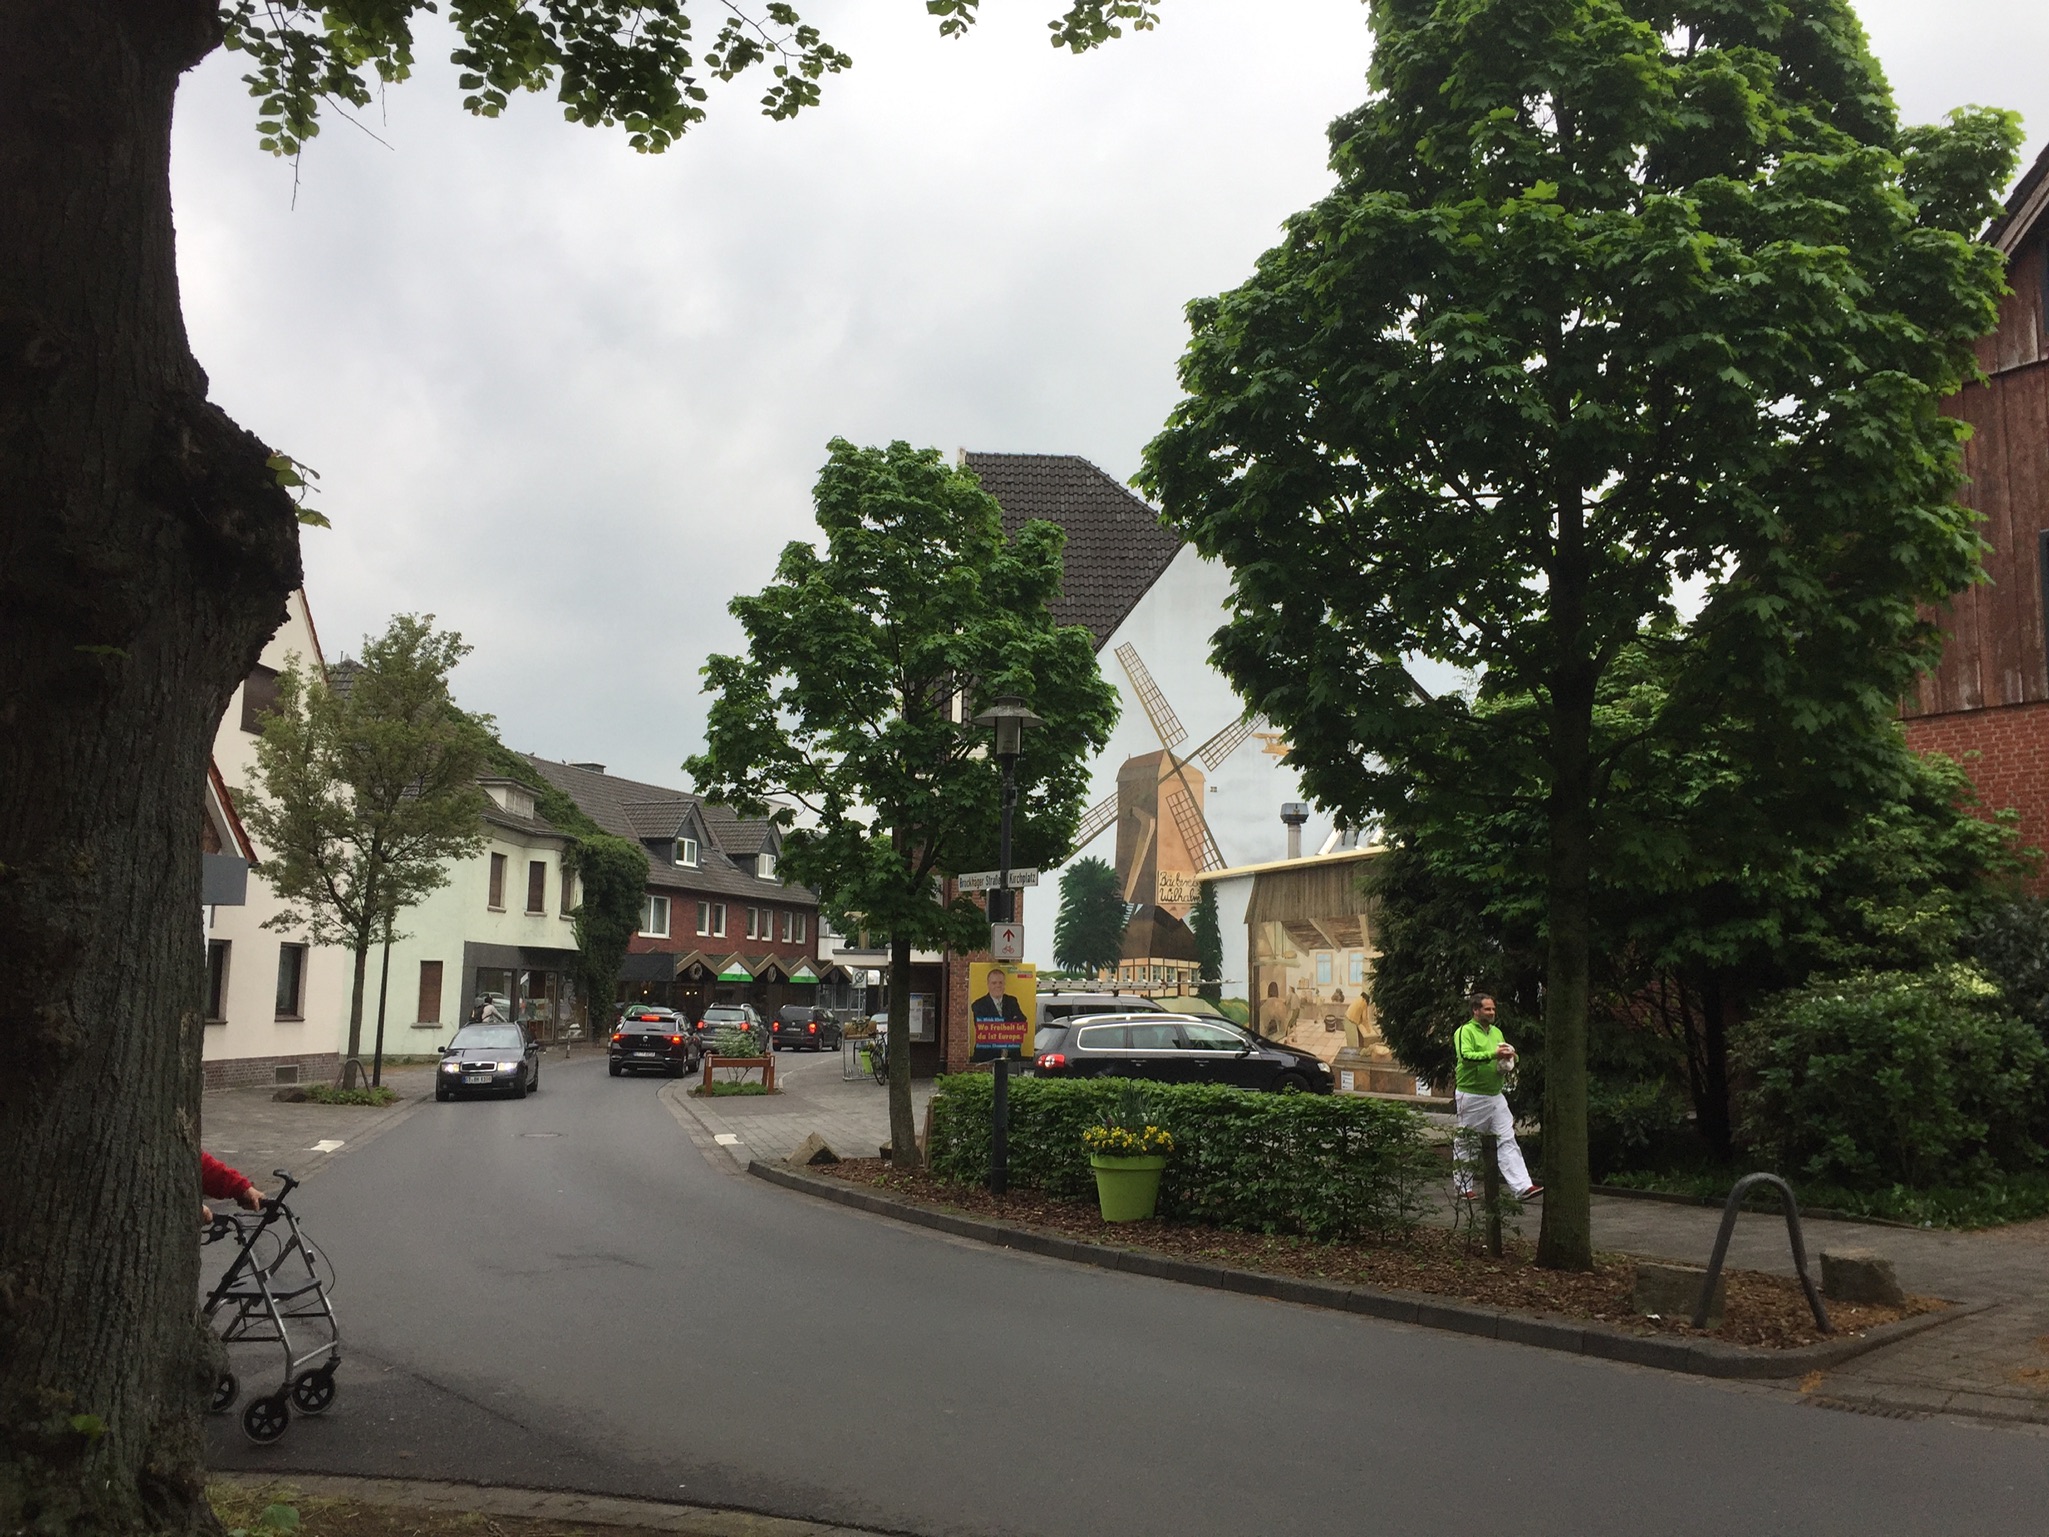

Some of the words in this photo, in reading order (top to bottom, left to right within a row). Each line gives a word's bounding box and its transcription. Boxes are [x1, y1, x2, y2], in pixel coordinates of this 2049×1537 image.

[1009, 872, 1036, 885] Kirchplatz
[977, 1032, 986, 1040] da
[988, 1032, 997, 1040] ist
